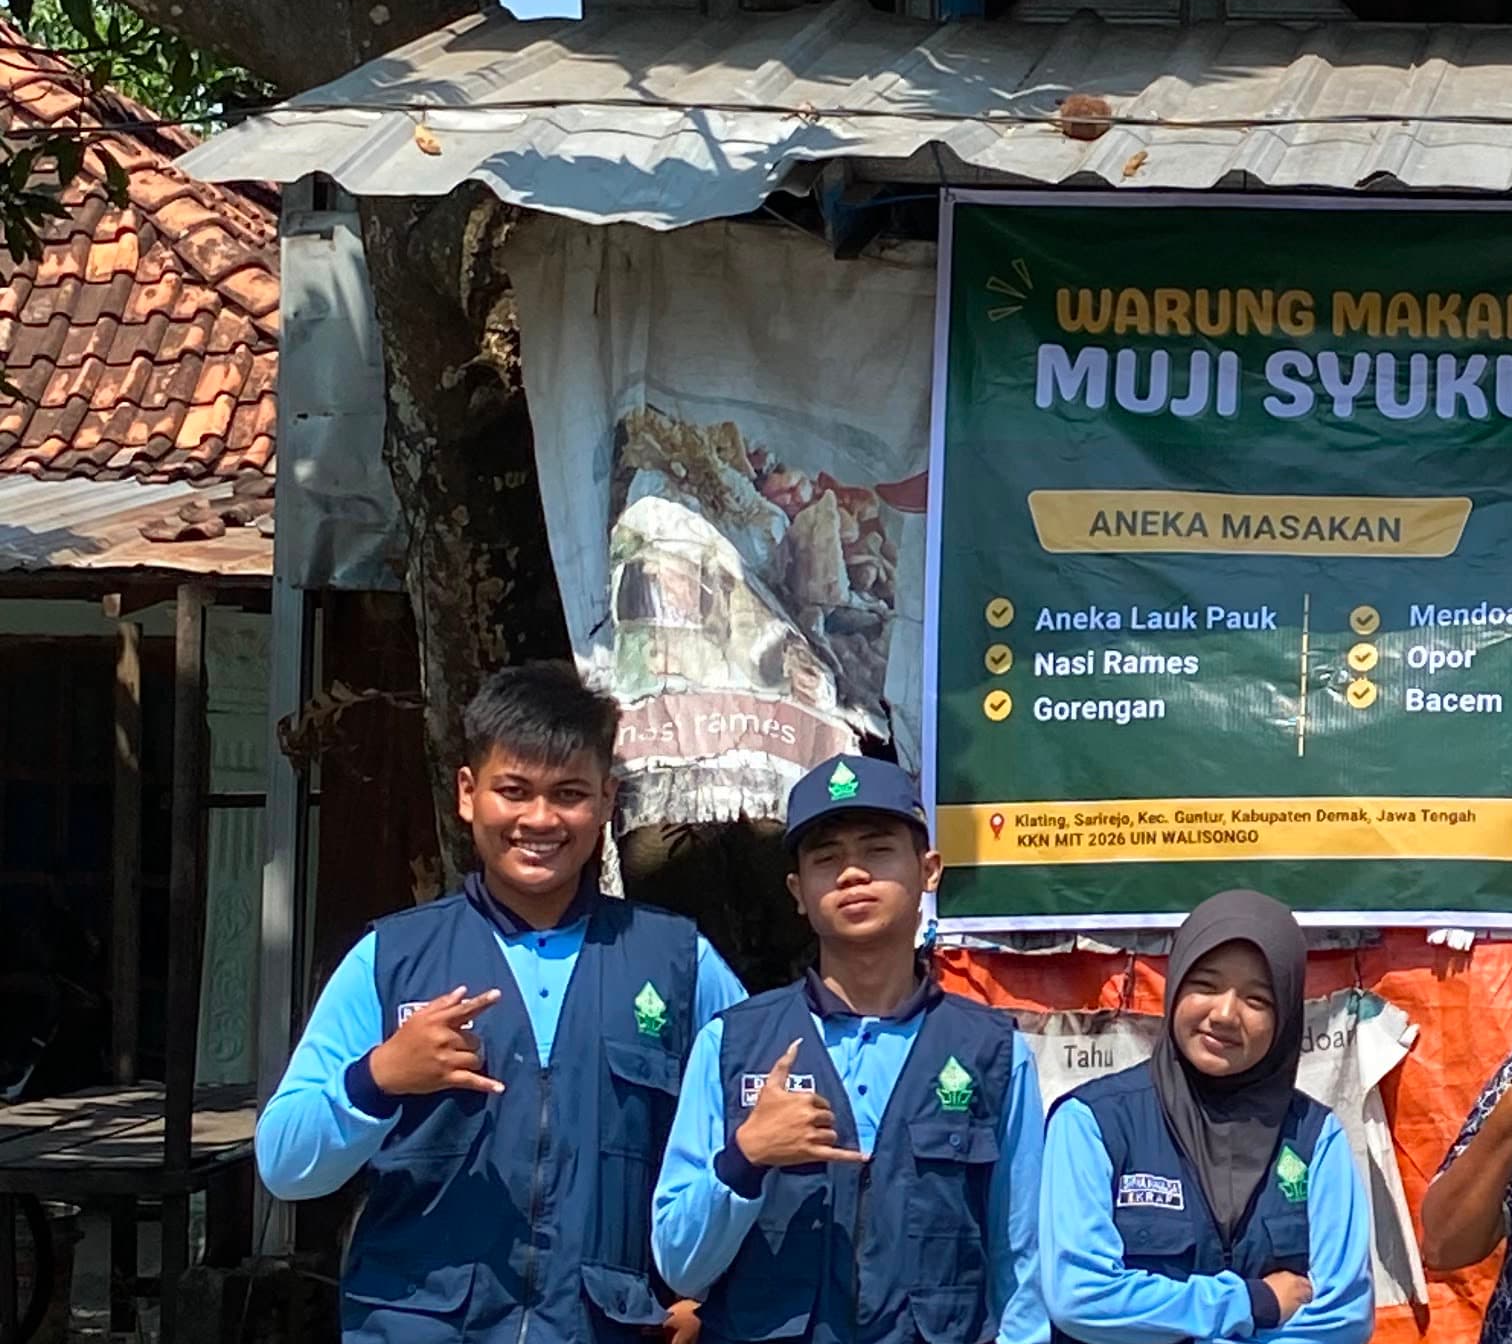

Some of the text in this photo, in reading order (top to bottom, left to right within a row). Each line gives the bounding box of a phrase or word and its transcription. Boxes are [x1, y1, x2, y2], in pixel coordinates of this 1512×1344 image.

[1056, 287, 1315, 337] WARUNG
[1035, 345, 1240, 418] MUJI
[1089, 510, 1402, 543] ANEKA MASAKAN
[1036, 606, 1277, 632] Aneka Lauk Pauk
[1035, 651, 1199, 676] Nasi Rames
[1407, 645, 1477, 673] Opor
[1034, 697, 1165, 725] Gorengan
[1405, 688, 1503, 715] Bacem
[617, 711, 797, 746] nas rames
[1015, 813, 1069, 830] Klating,
[1074, 811, 1134, 829] Sarirejo,
[1138, 811, 1168, 825] Kec.
[1231, 809, 1311, 826] Kabupaten
[1316, 808, 1372, 824] Demak,
[1376, 809, 1416, 823] Jawa
[1421, 808, 1477, 825] Tengah
[1017, 829, 1260, 848] KKN MIT 2026 UIN WALISONGO
[1302, 1025, 1359, 1055] doan
[1064, 1044, 1114, 1070] Tahu
